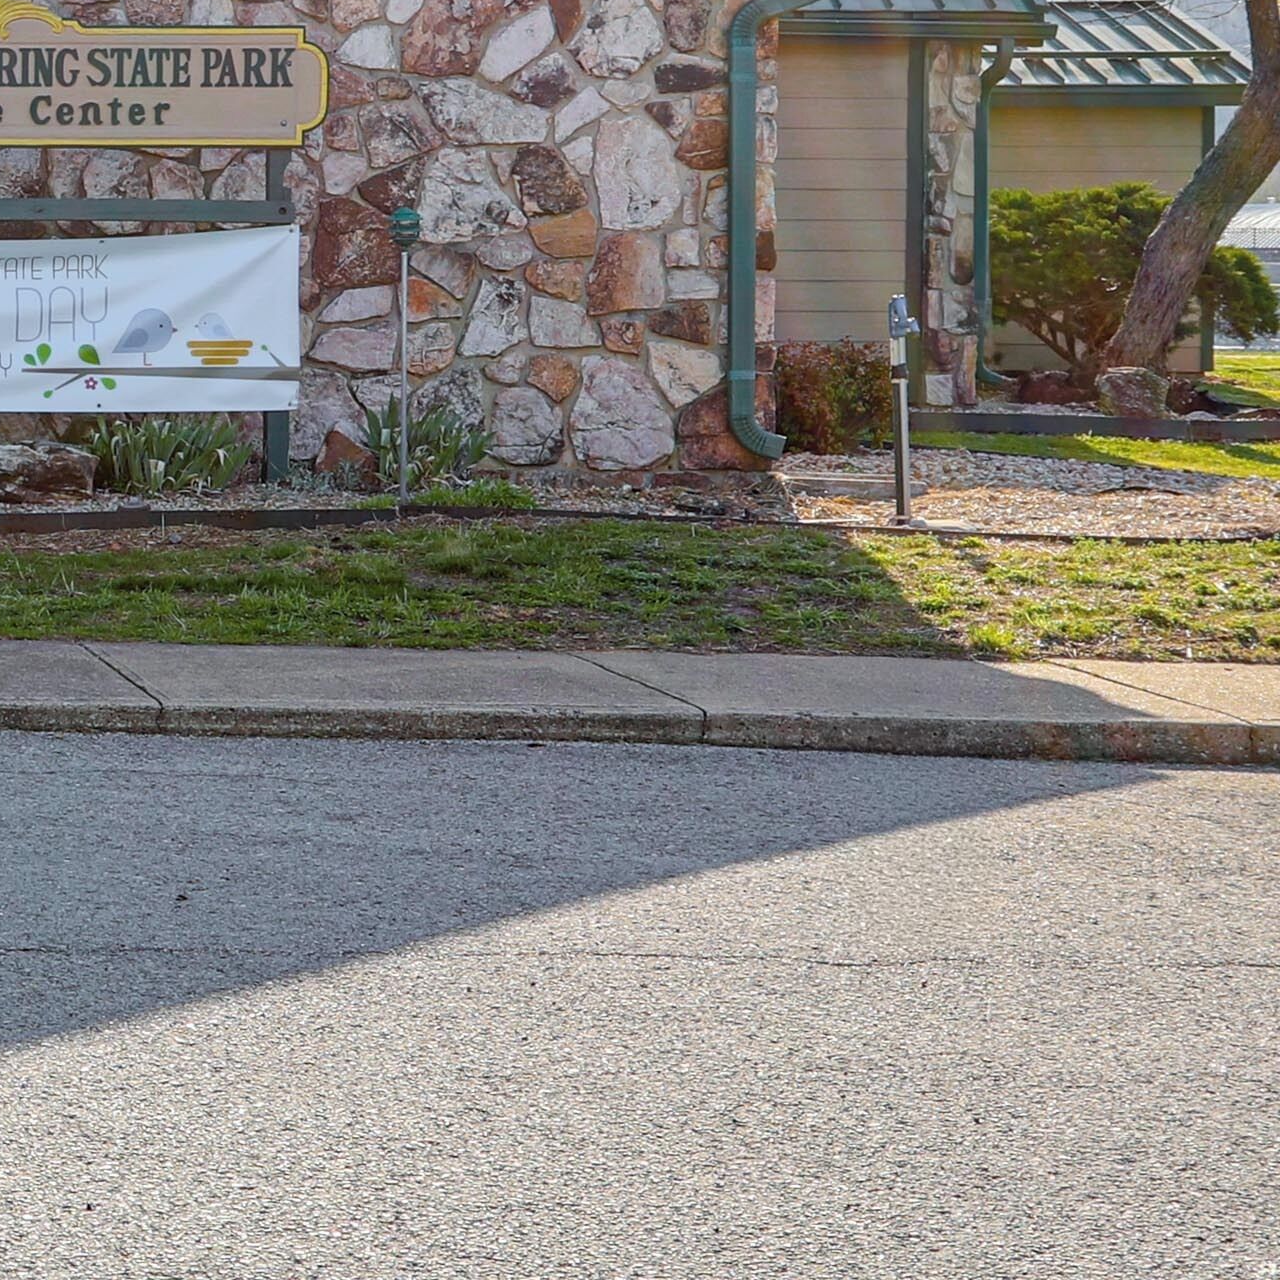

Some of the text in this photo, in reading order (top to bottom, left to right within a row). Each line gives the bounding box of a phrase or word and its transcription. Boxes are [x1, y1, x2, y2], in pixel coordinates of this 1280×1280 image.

[86, 47, 191, 88] STATE
[199, 47, 296, 88] PARK
[29, 95, 171, 126] Center
[52, 254, 109, 280] PARK
[15, 285, 109, 343] DAY
